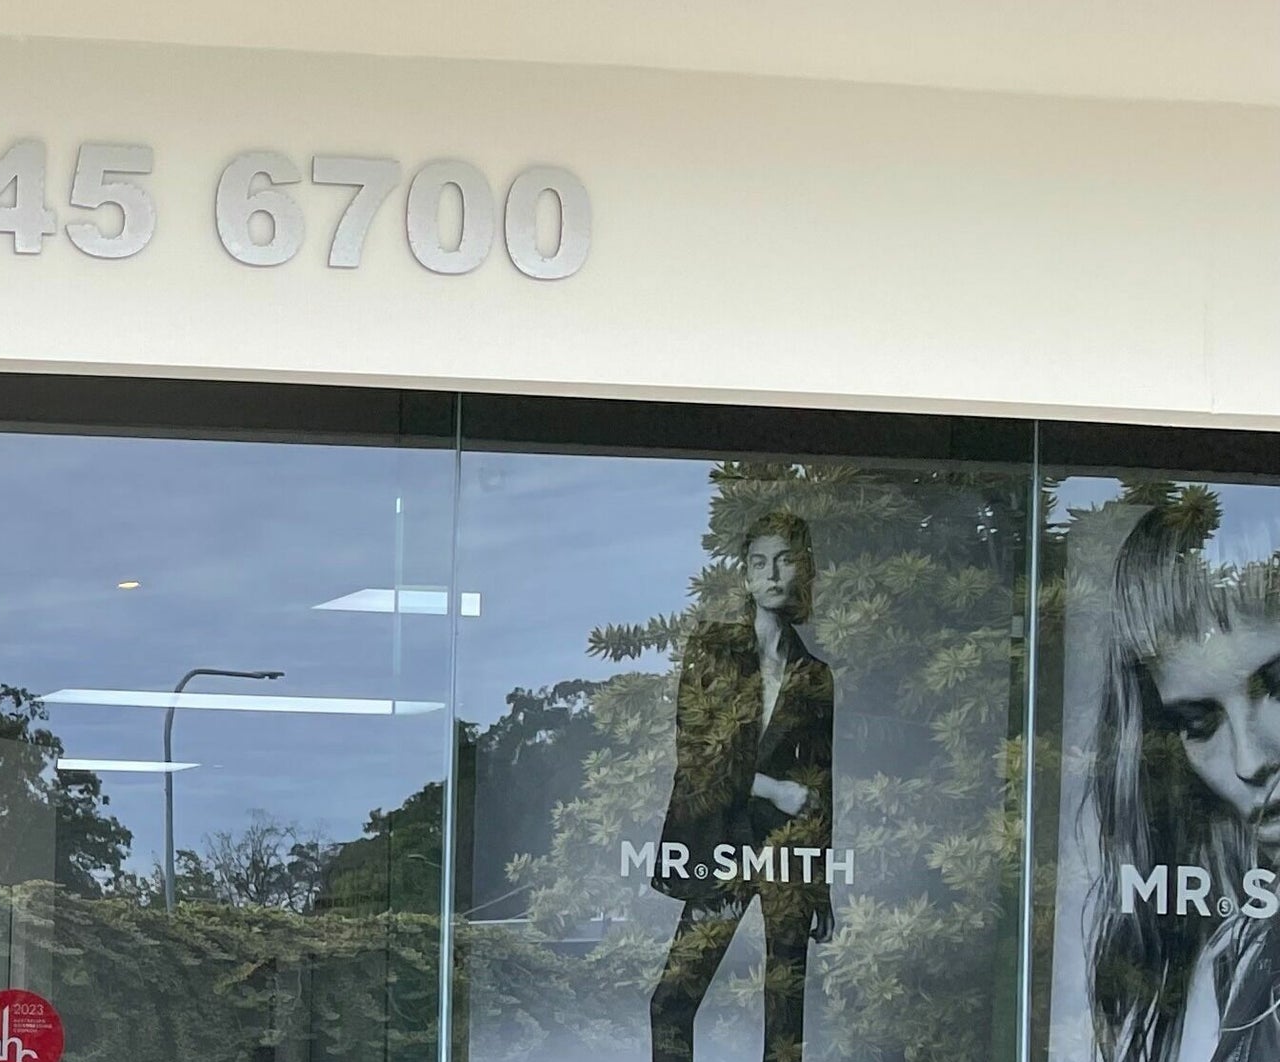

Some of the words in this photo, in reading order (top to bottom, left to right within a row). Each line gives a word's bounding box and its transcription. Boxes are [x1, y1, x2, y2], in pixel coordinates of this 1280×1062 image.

[214, 150, 593, 281] 6700
[712, 843, 855, 885] SMITH
[12, 1003, 44, 1016] 2023
